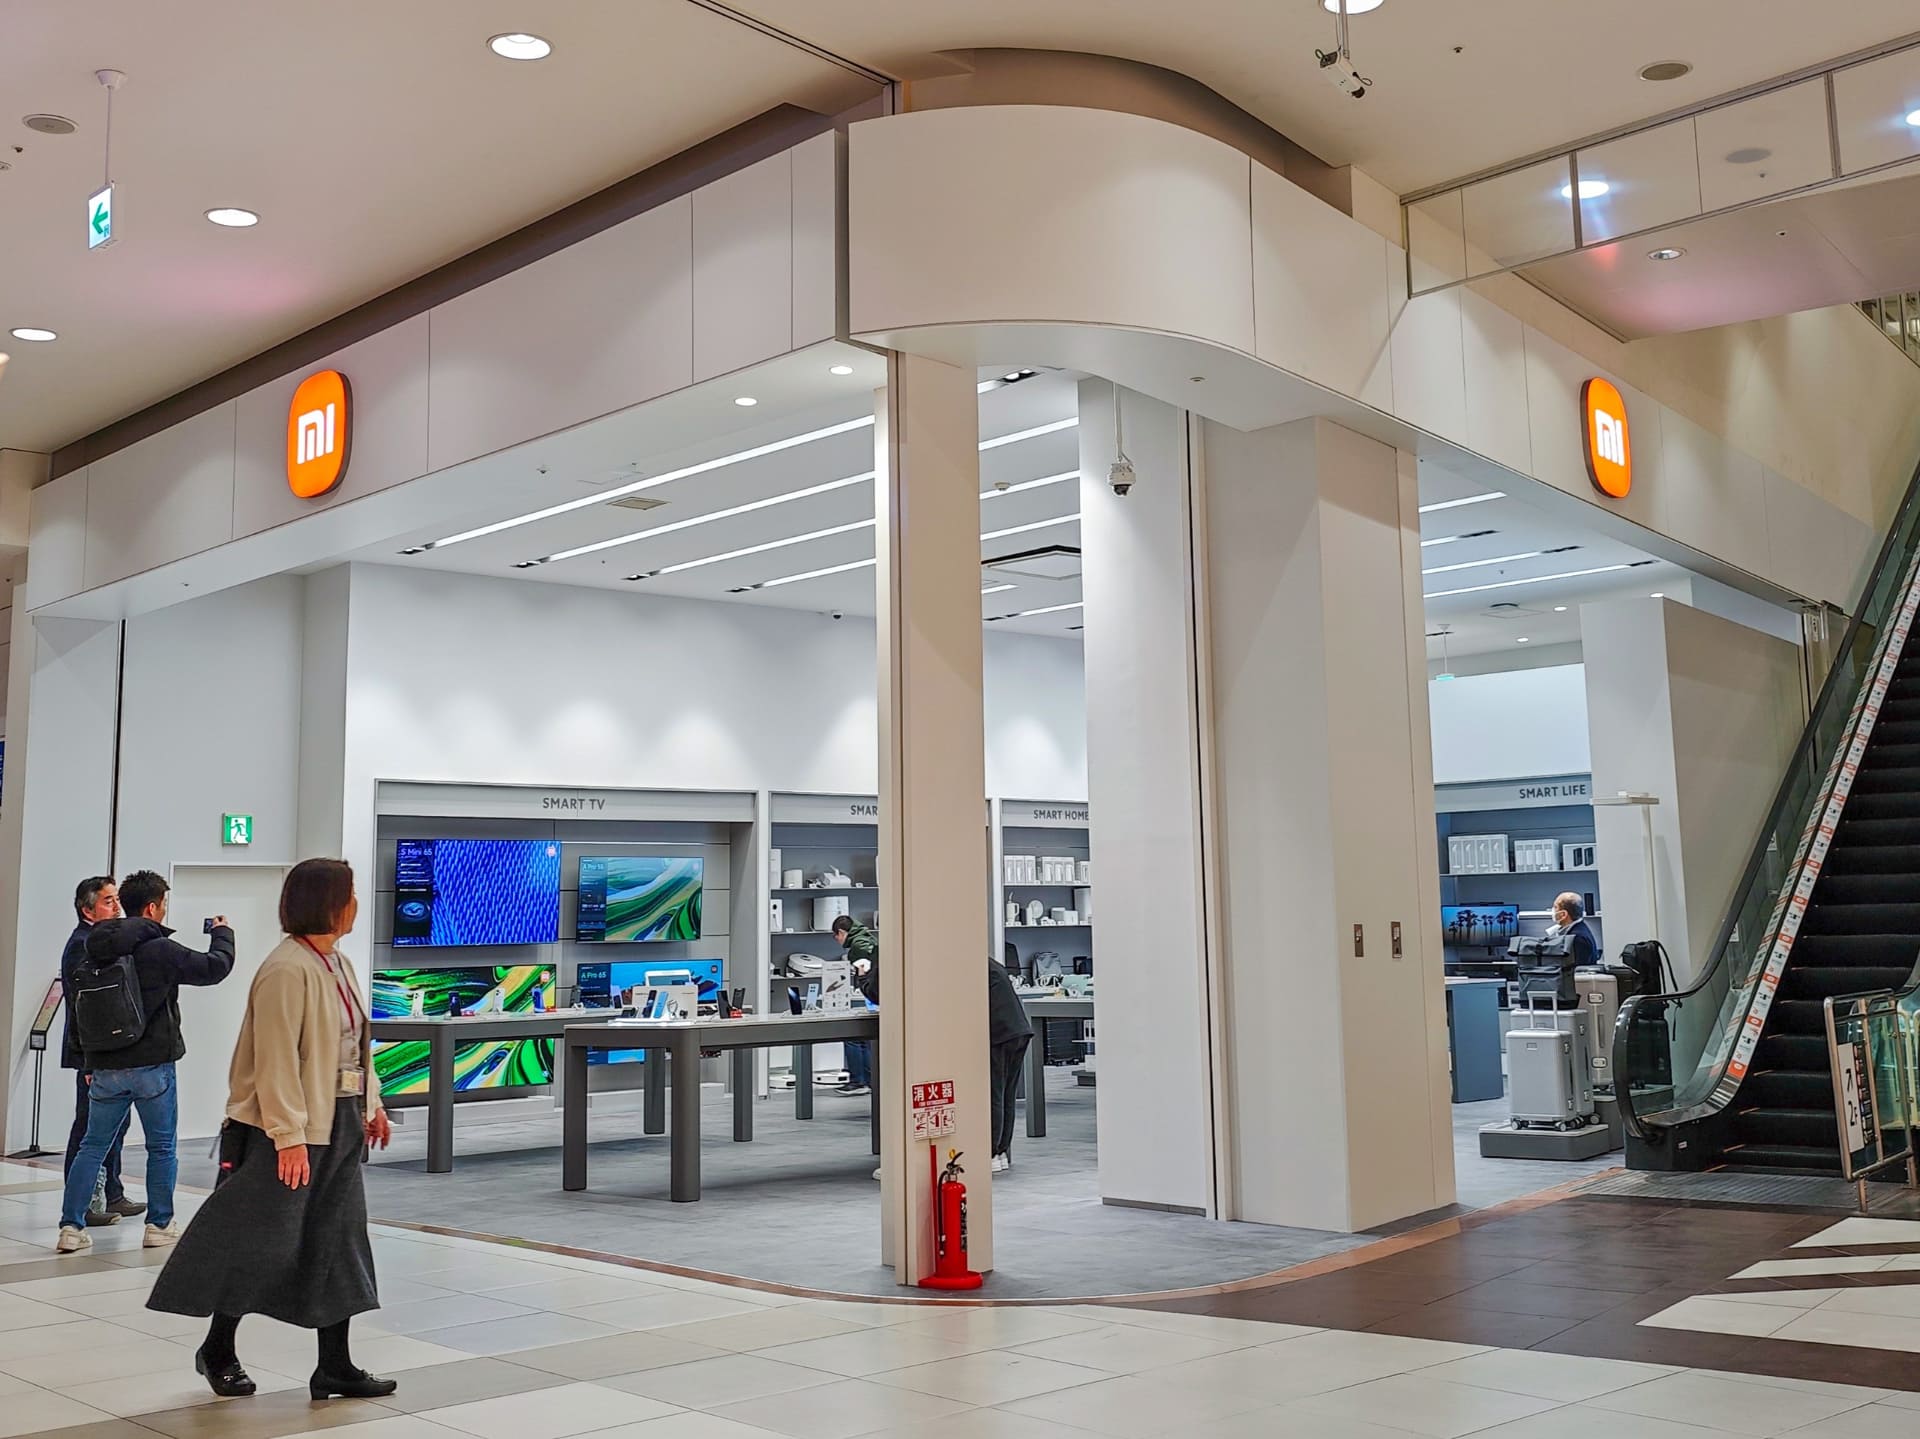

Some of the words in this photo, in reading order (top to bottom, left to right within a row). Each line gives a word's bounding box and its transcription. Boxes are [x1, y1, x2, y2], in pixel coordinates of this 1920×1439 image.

[1519, 786, 1558, 799] SMART
[1562, 784, 1586, 796] LIFE
[542, 797, 585, 810] SMART
[589, 798, 605, 810] TV
[1033, 809, 1062, 820] SMART
[1065, 810, 1089, 821] HOME
[913, 1082, 953, 1102] 消火器
